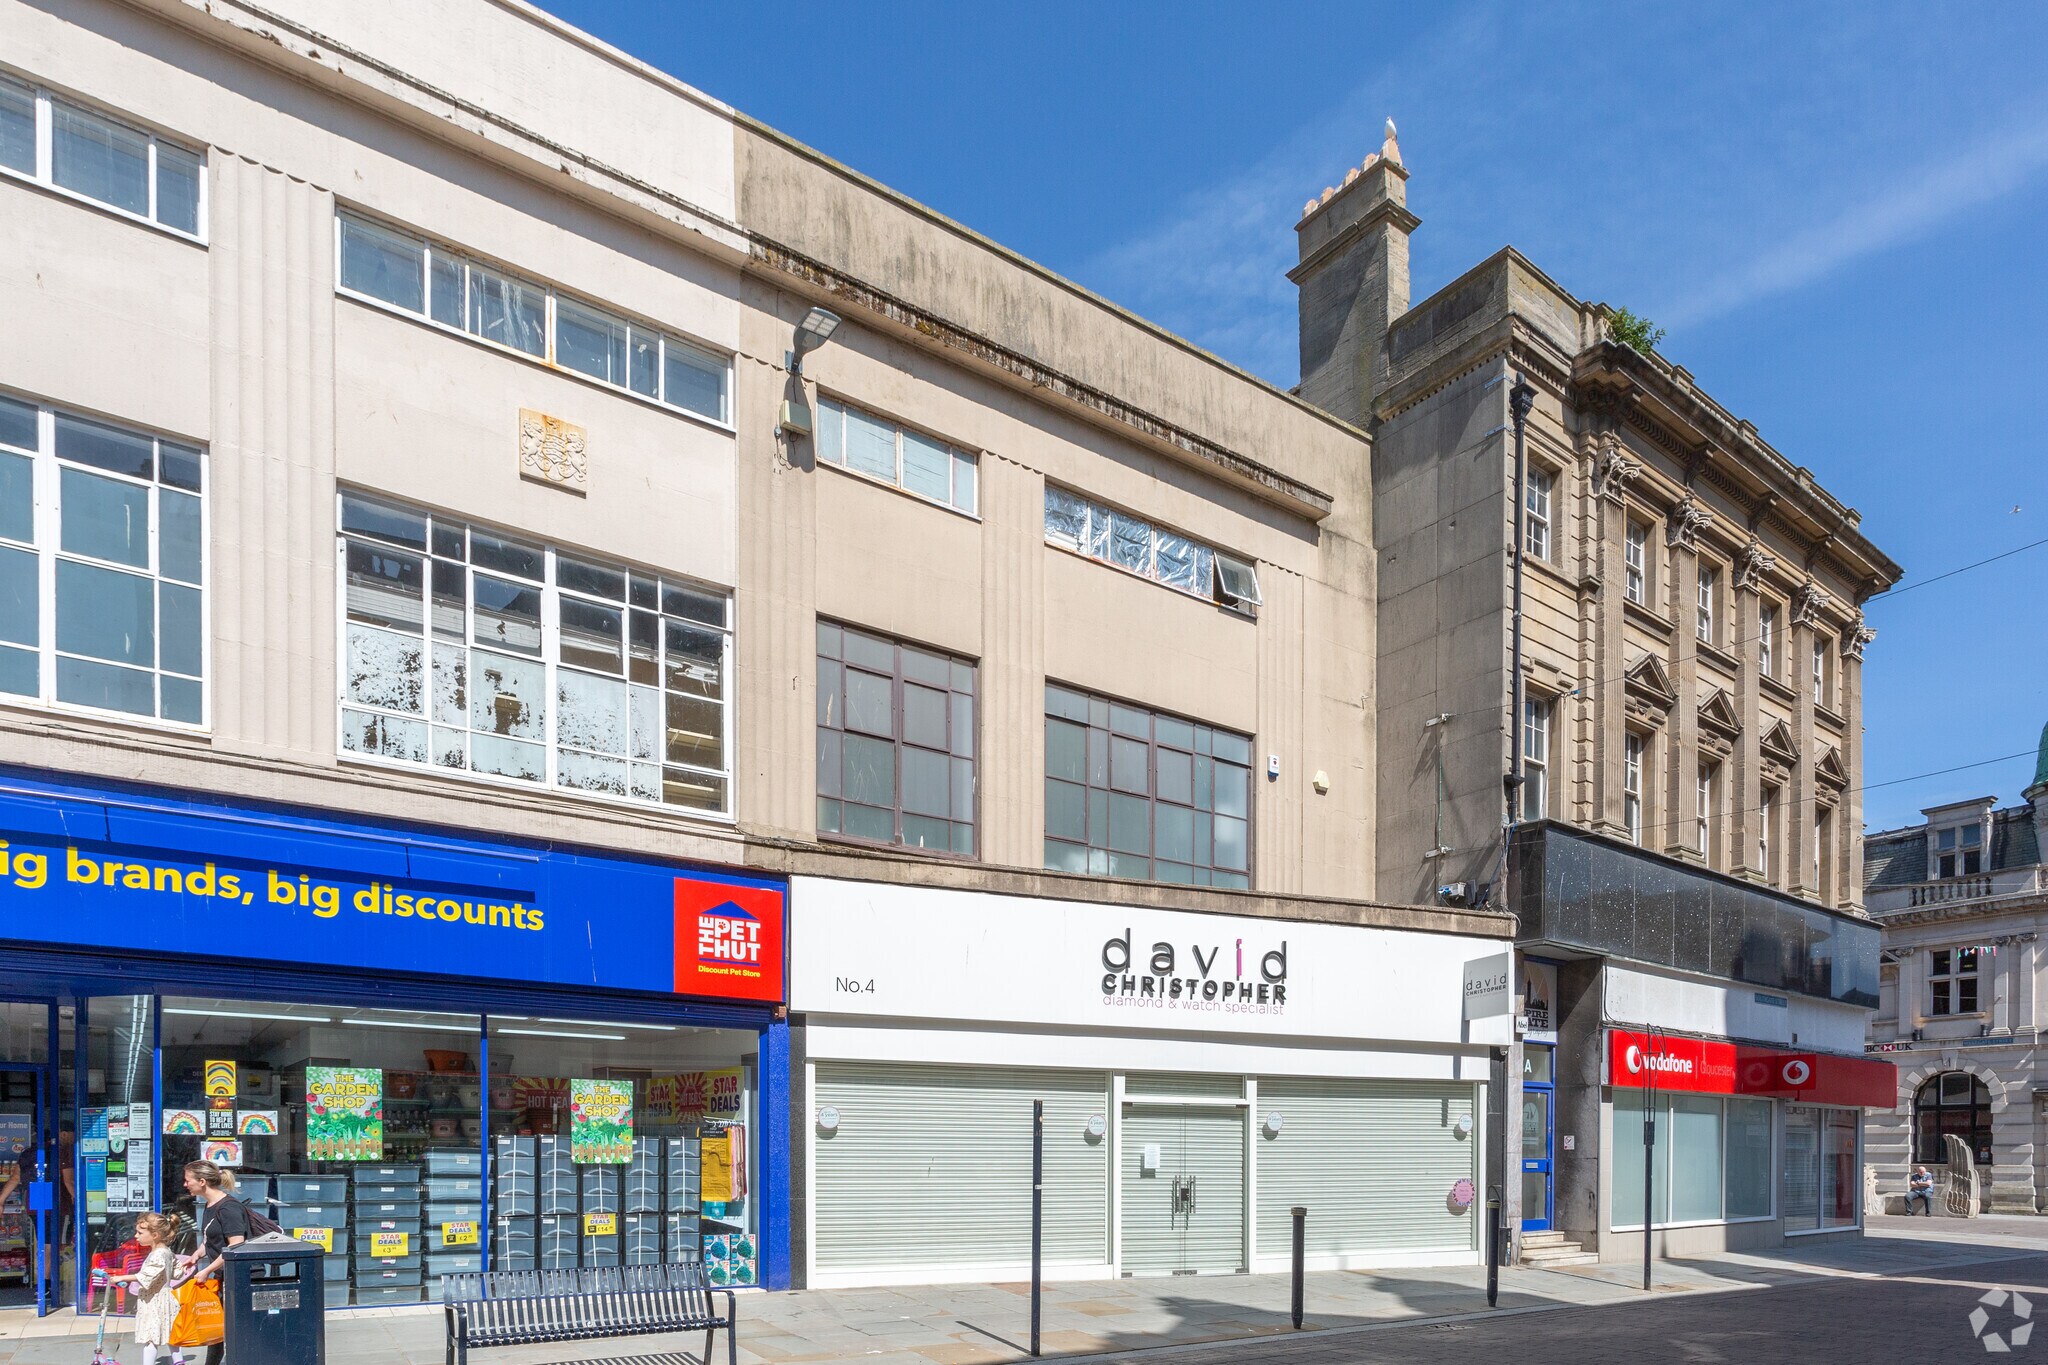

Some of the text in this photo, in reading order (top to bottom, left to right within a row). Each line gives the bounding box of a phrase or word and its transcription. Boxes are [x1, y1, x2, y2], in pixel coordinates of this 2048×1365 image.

[0, 839, 545, 931] ig brands, big discounts
[698, 916, 714, 956] THE
[714, 918, 761, 942] PET
[714, 940, 761, 961] HUT
[1101, 927, 1287, 984] david
[698, 965, 761, 978] Discount Pet Store
[836, 976, 875, 994] No.4
[1101, 974, 1287, 1006] CHRISTOPHER
[1466, 972, 1507, 991] david
[1466, 984, 1507, 997] CHRISTOPHER
[1102, 994, 1284, 1016] diamond & watch specialist
[1524, 1009, 1548, 1019] PIRE
[1528, 1018, 1548, 1028] ATE
[1864, 1042, 1913, 1052] BC UK
[1642, 1052, 1733, 1077] vodafone Gloucester
[334, 1074, 355, 1082] THE
[714, 1076, 737, 1094] STAR
[310, 1082, 378, 1096] GARDEN
[650, 1085, 670, 1101] STAR
[324, 1096, 366, 1108] SHOP
[528, 1096, 570, 1109] HOT DEA
[574, 1093, 630, 1105] GARDEN
[710, 1094, 740, 1113] DEALS
[585, 1106, 620, 1117] SHOP
